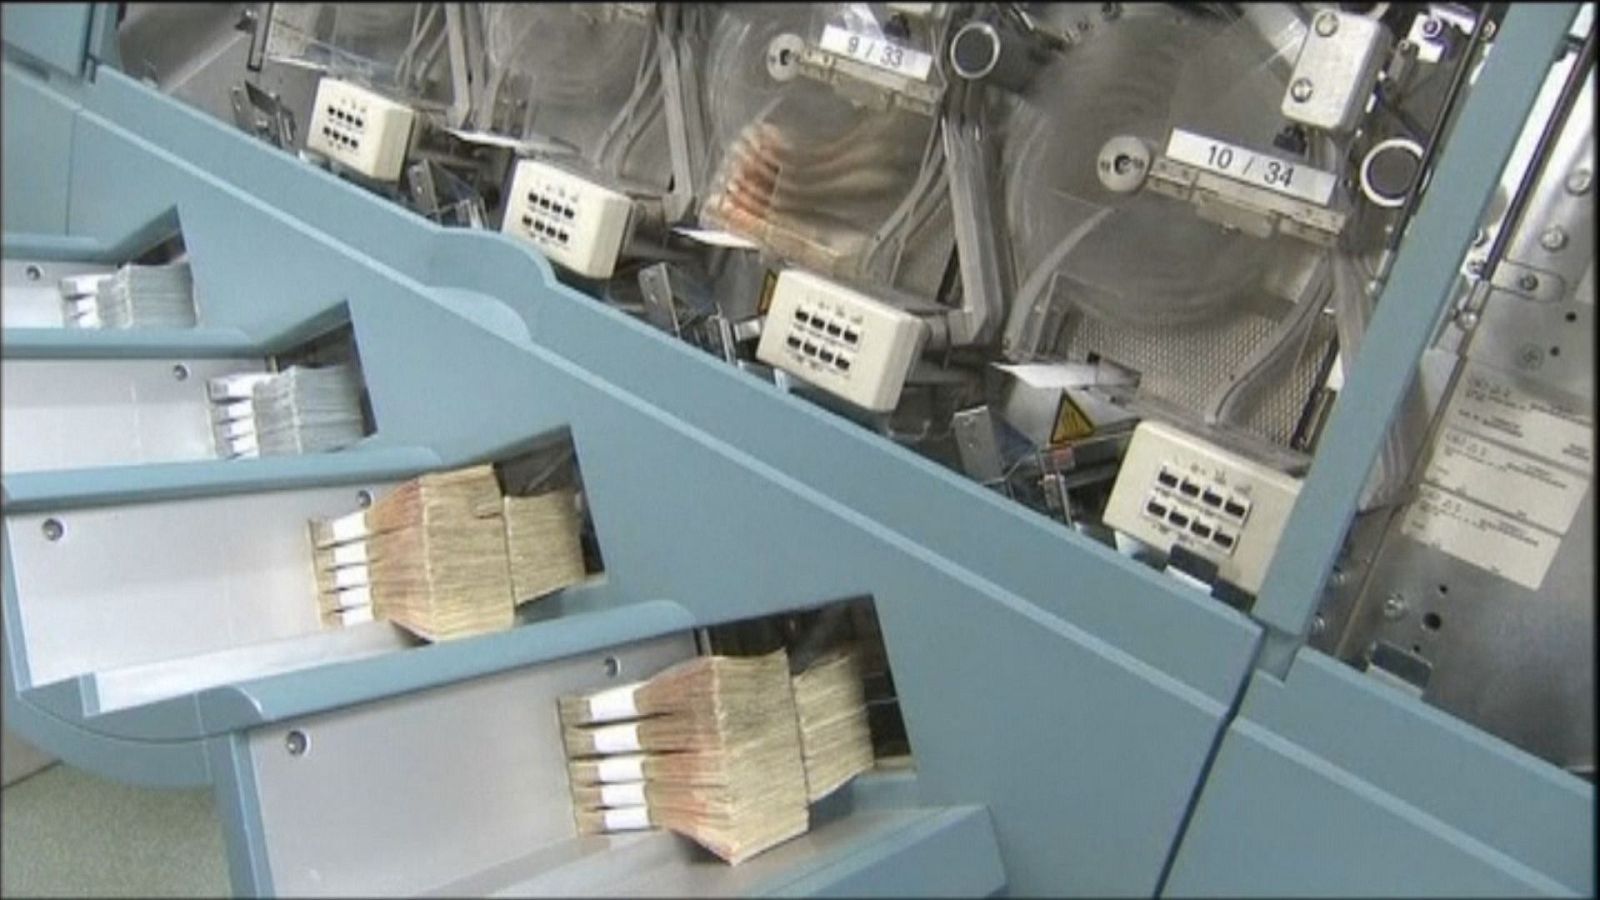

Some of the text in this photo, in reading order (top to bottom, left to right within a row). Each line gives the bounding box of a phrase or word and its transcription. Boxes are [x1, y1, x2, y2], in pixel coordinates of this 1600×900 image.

[847, 36, 860, 54] 9
[880, 45, 903, 68] 33
[1208, 144, 1234, 170] 10
[1263, 161, 1294, 188] 34
